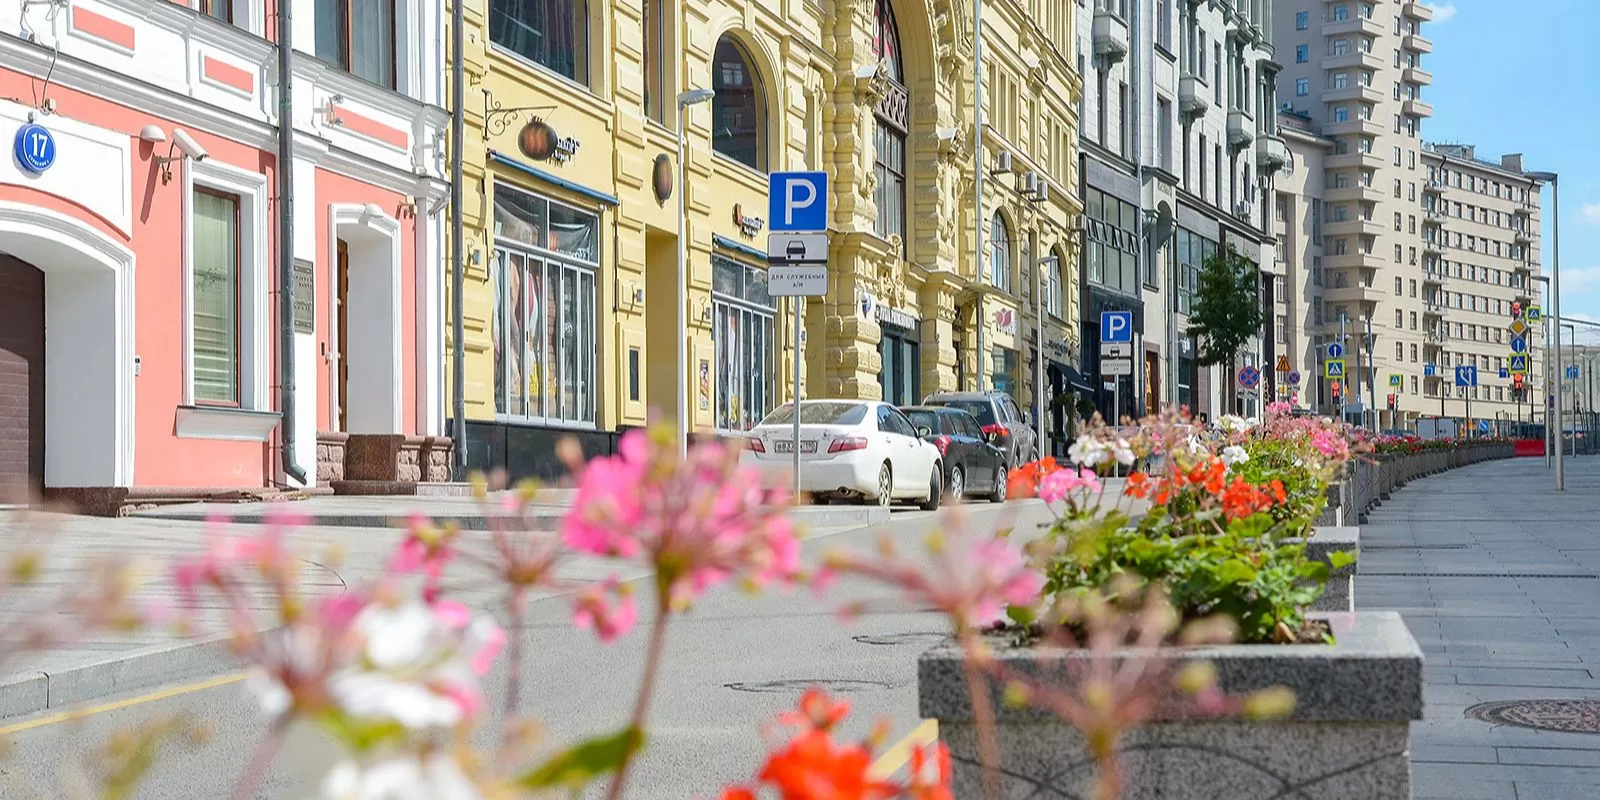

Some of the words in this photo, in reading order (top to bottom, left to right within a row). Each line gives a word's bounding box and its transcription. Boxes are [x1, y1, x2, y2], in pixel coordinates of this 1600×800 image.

[31, 133, 48, 158] 17
[785, 178, 817, 226] P
[1109, 315, 1126, 339] P
